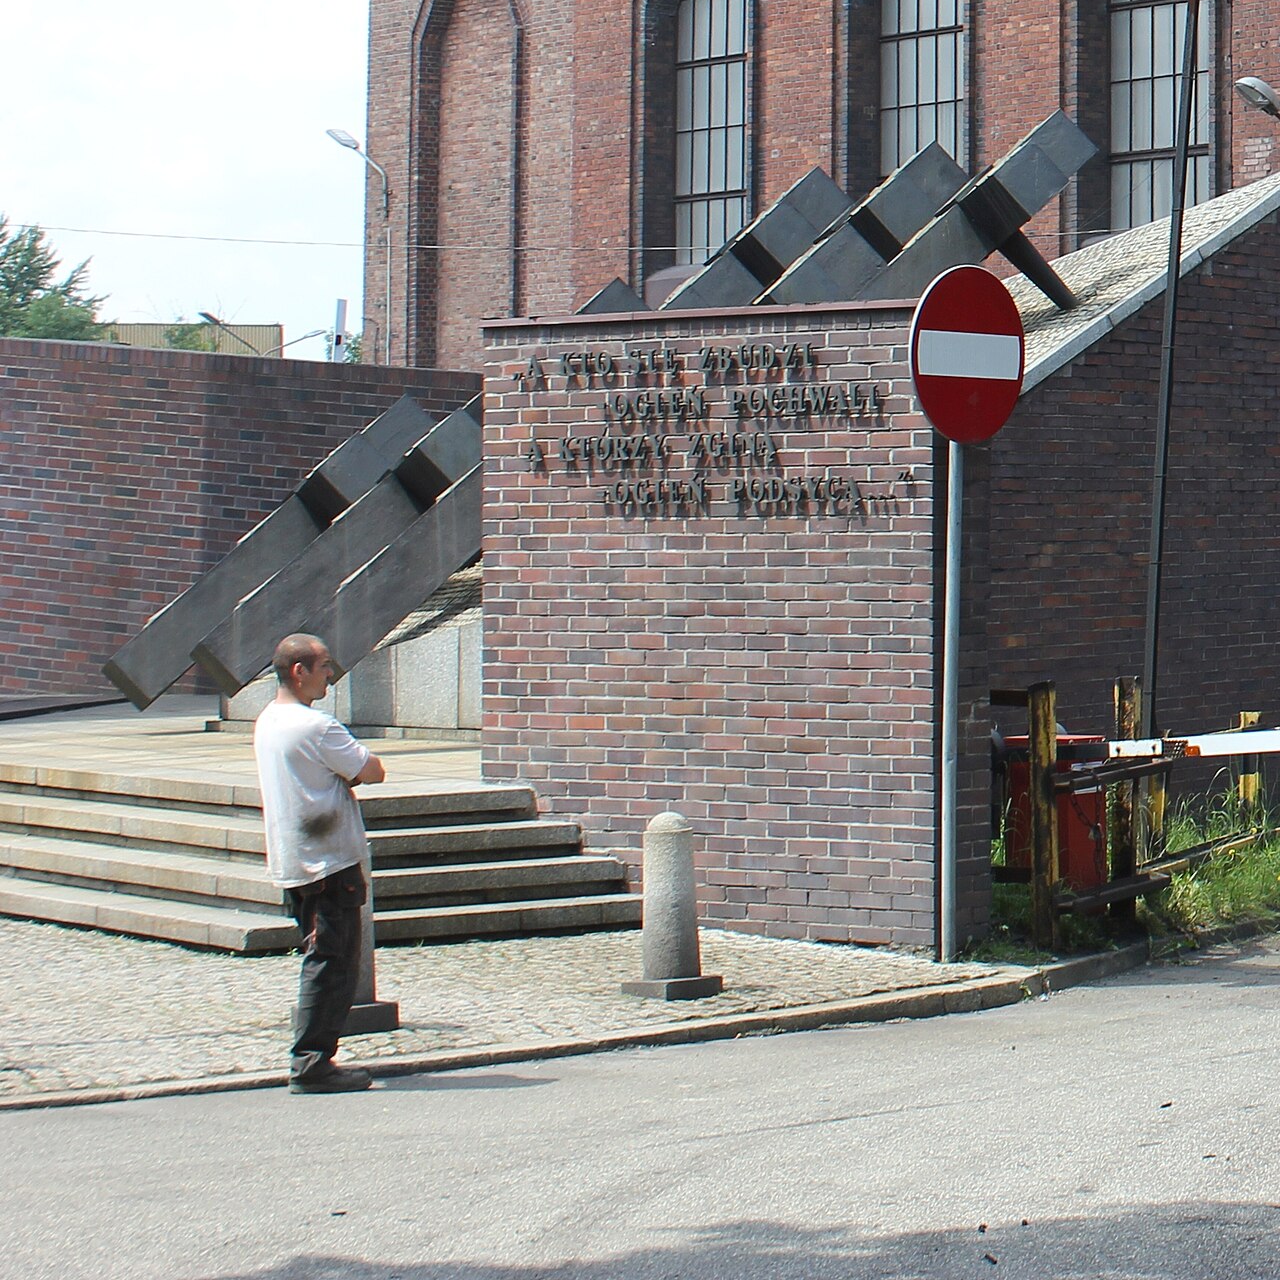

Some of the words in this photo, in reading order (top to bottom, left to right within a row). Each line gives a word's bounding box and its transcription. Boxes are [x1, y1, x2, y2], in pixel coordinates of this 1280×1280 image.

[559, 350, 612, 376] KTO
[627, 347, 678, 379] SIĘ
[699, 342, 814, 372] ZBUDZI
[727, 383, 880, 415] POCHWALI
[528, 438, 543, 462] A
[559, 427, 667, 462] KTÓRZY
[687, 429, 777, 463] ZGINĄ
